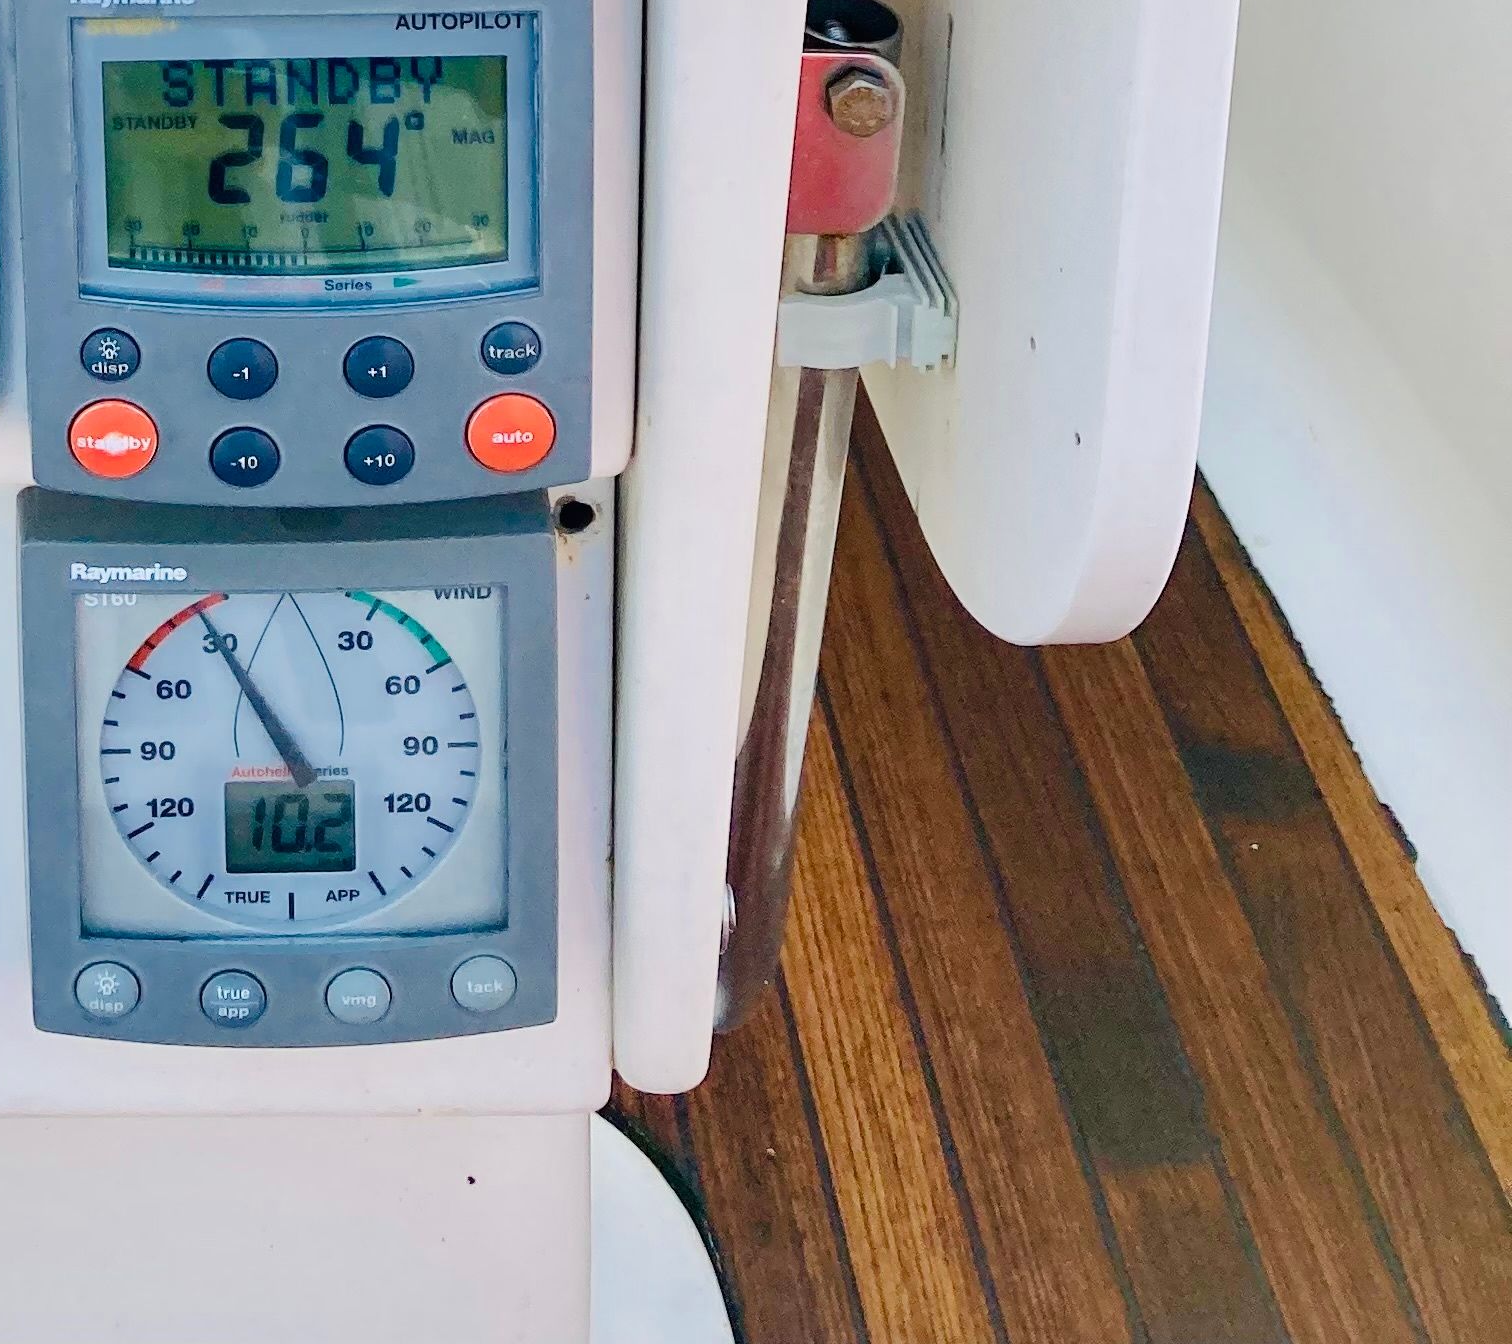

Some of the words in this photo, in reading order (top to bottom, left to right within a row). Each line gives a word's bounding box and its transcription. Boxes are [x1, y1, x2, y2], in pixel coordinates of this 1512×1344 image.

[395, 13, 524, 31] AUTOPILOT
[162, 59, 443, 107] STANDBY
[112, 115, 197, 130] STANDBY
[452, 128, 495, 145] MAG
[324, 279, 373, 292] Series
[488, 342, 537, 359] track
[91, 361, 129, 375] disp
[233, 368, 250, 380] -1
[367, 366, 388, 379] +1
[492, 430, 534, 444] auto
[230, 456, 258, 470] -10
[363, 453, 396, 468] +10
[70, 562, 188, 583] Raymarine
[434, 586, 492, 600] WIND
[338, 630, 374, 652] 30
[156, 680, 192, 700] 60
[386, 675, 421, 696] 60
[140, 740, 176, 762] 90
[403, 736, 439, 757] 90
[232, 765, 291, 778] Autohel
[310, 765, 349, 777] eries
[146, 798, 195, 818] 120
[384, 793, 431, 813] 120
[224, 891, 271, 904] TRUE
[325, 889, 360, 902] APP
[217, 986, 250, 1000] true
[467, 979, 504, 995] tack
[89, 998, 124, 1014] disp
[342, 993, 377, 1009] vmg
[218, 1006, 249, 1019] app
